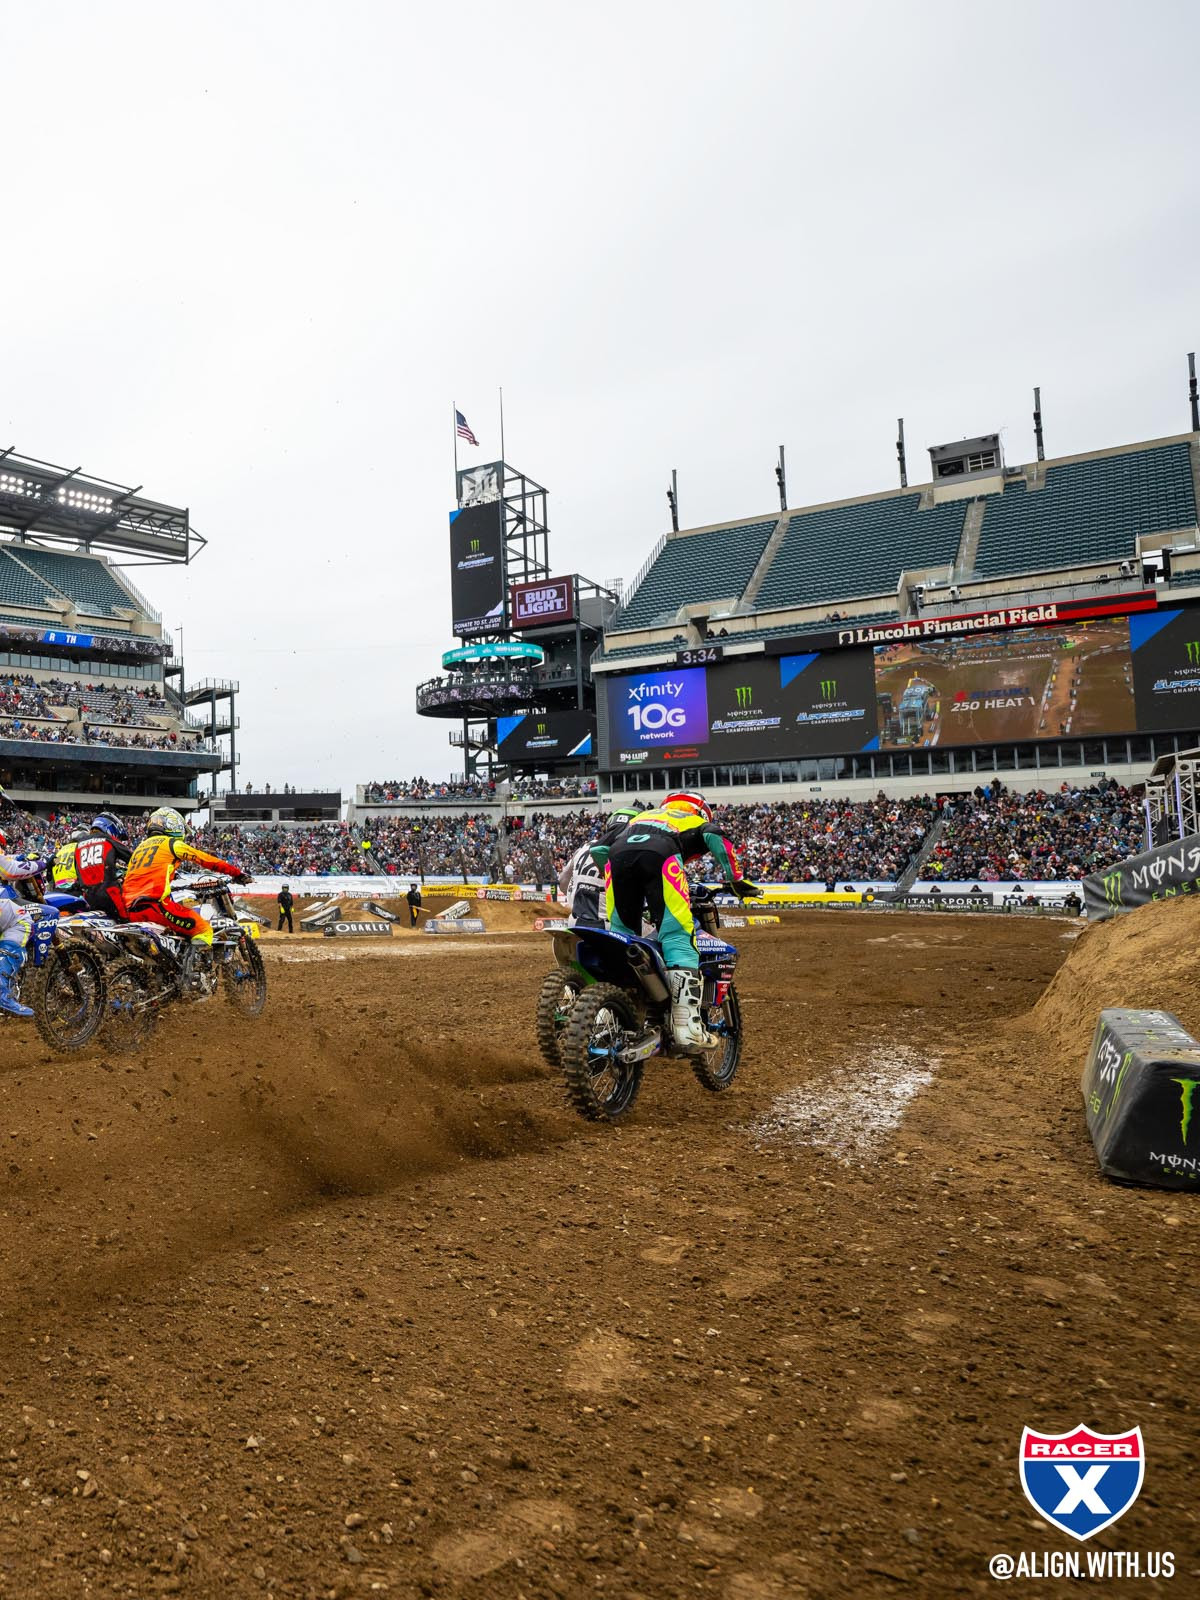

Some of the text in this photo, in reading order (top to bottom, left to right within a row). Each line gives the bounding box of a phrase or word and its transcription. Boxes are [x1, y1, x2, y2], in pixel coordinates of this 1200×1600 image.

[525, 589, 558, 603] BUD
[520, 598, 564, 615] LIGHT
[857, 605, 1057, 643] Lincoln Financial Field
[682, 648, 717, 664] 3:34
[628, 681, 684, 701] xfinity
[951, 701, 980, 712] 250
[985, 698, 1023, 709] HEAT
[627, 703, 686, 731] 10G
[727, 709, 763, 717] MONSTER
[640, 731, 674, 740] network
[80, 844, 103, 869] 242
[941, 898, 989, 906] SPORTS
[38, 919, 58, 929] FXR
